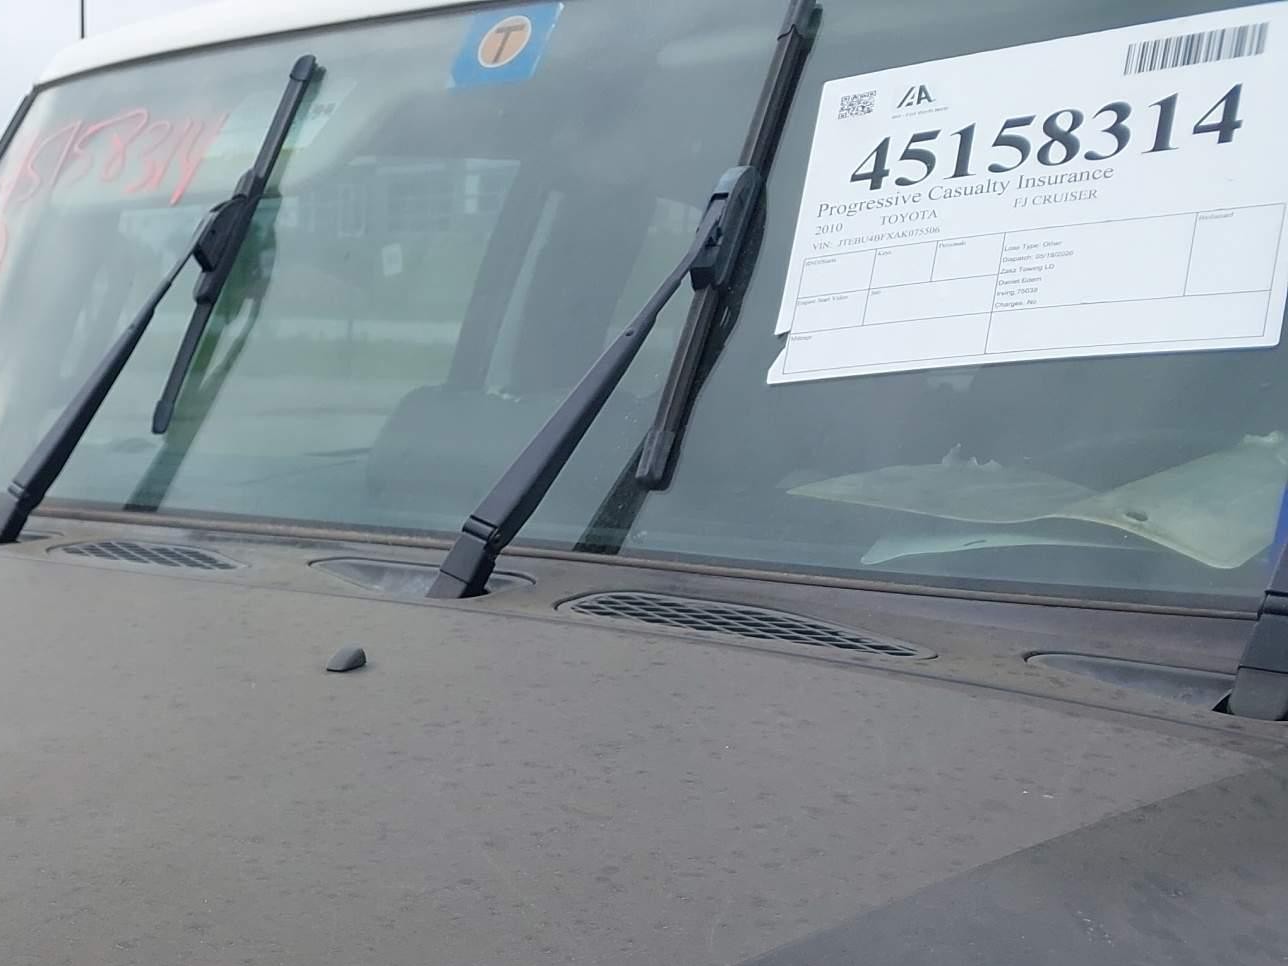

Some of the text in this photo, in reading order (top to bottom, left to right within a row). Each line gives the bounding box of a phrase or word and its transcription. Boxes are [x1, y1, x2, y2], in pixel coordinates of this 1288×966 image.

[496, 24, 526, 62] T
[850, 82, 1244, 191] 45158314
[815, 189, 1098, 236] 2010 TOYOTA FJ CRUISER
[816, 167, 1115, 219] Progressive Casualty Insurance
[812, 242, 833, 251] VIN:
